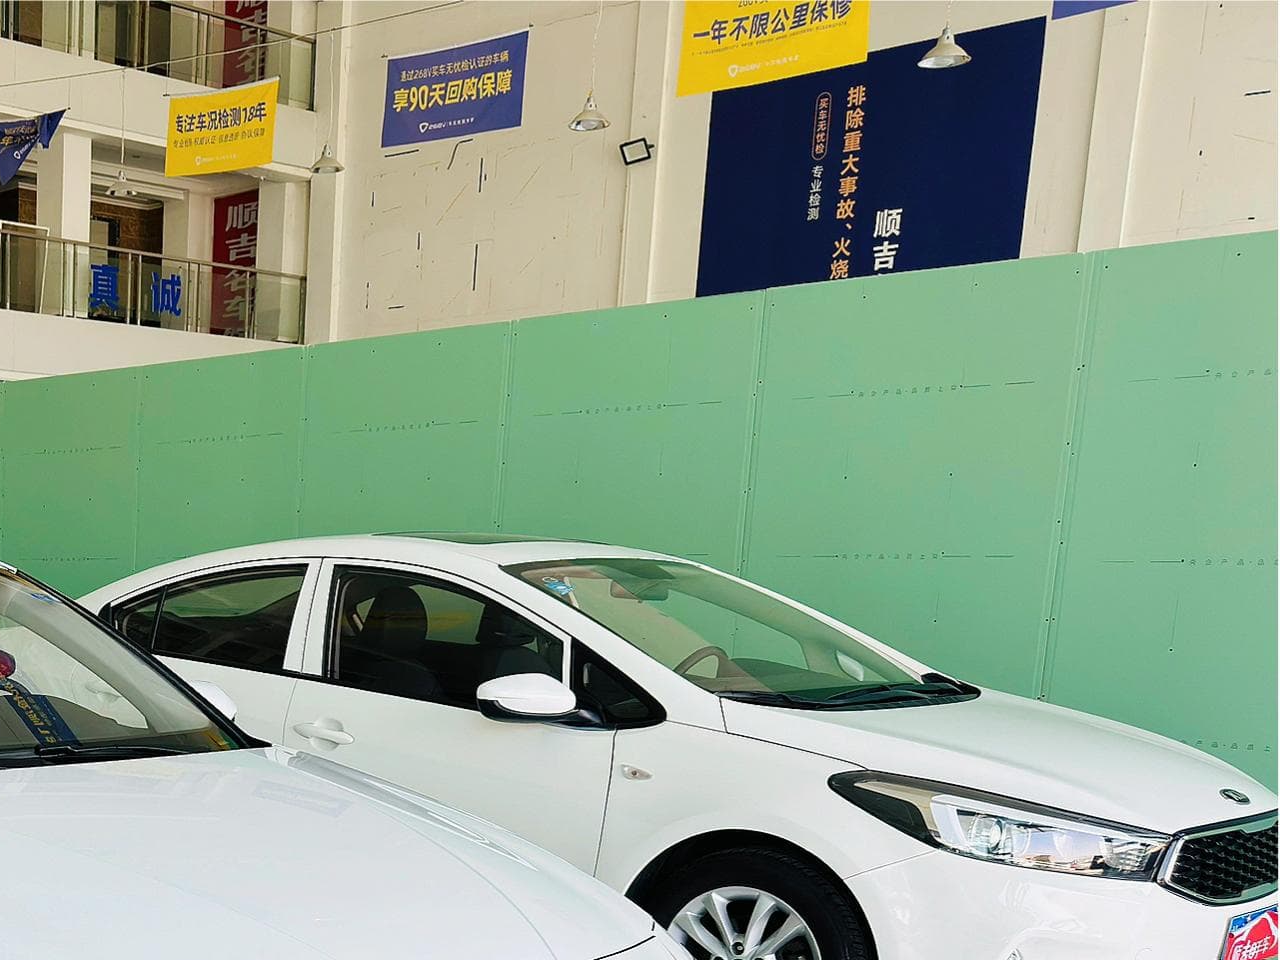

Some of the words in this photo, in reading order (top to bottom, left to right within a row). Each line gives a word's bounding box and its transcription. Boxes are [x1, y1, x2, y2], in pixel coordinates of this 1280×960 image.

[693, 0, 852, 45] 一年不限公里保修
[393, 69, 513, 112] 享90天回购保障
[400, 50, 509, 82] 通过268V买车无忧检认证的车辆
[175, 102, 267, 134] 专注车况检测18年
[815, 97, 829, 155] 买车无忧检
[807, 166, 823, 221] 专业检测
[829, 85, 867, 280] 排除重大事故、火烧
[222, 200, 259, 338] 顺吉名车
[873, 208, 903, 276] 顺吉
